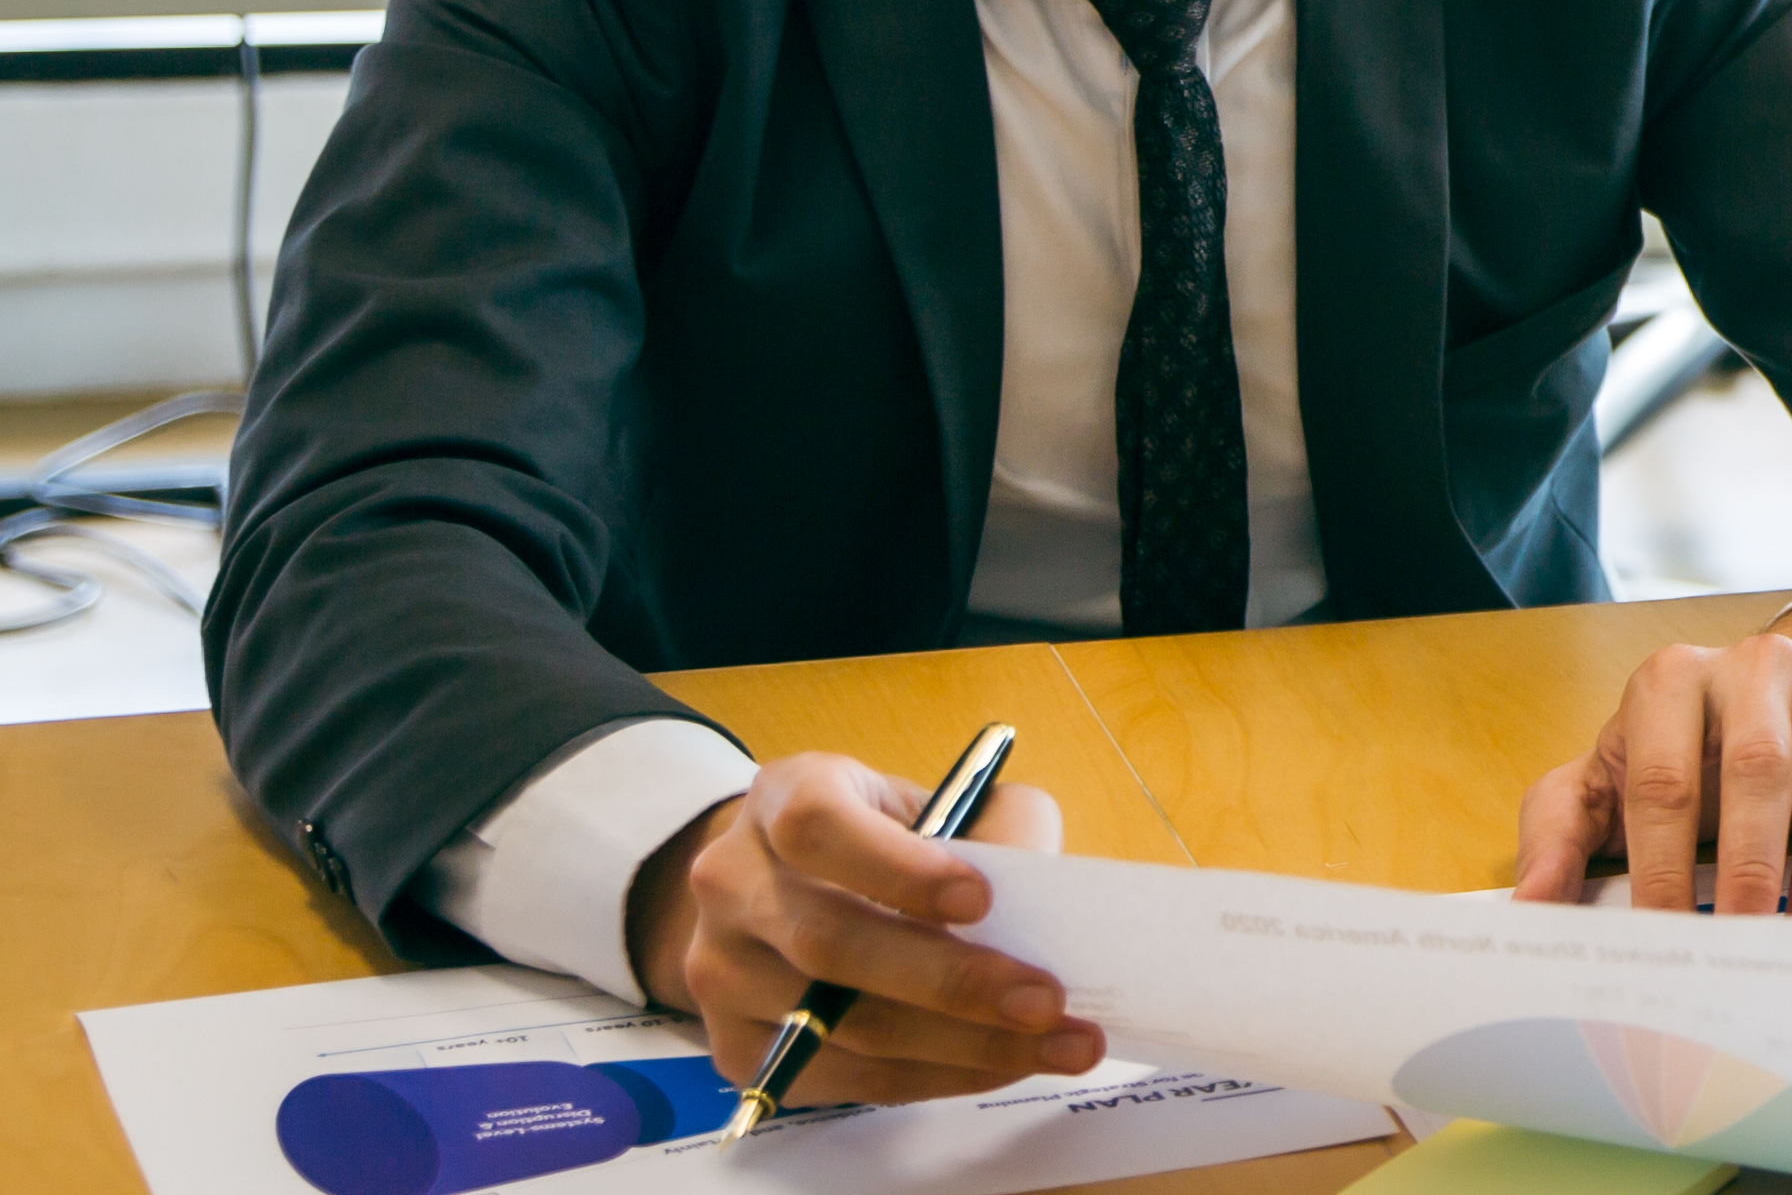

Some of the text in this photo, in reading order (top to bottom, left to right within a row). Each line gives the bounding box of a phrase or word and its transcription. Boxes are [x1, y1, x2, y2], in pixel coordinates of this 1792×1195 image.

[437, 1035, 529, 1052] 10+ years
[1064, 1080, 1149, 1097] Strategic
[1153, 1076, 1180, 1085] for
[977, 1094, 1062, 1110] Planning
[1068, 1091, 1166, 1113] PLAN
[478, 1109, 592, 1130] Disruption &
[487, 1103, 574, 1119] Evolution
[475, 1117, 605, 1141] Systems-Level
[750, 1123, 784, 1137] and
